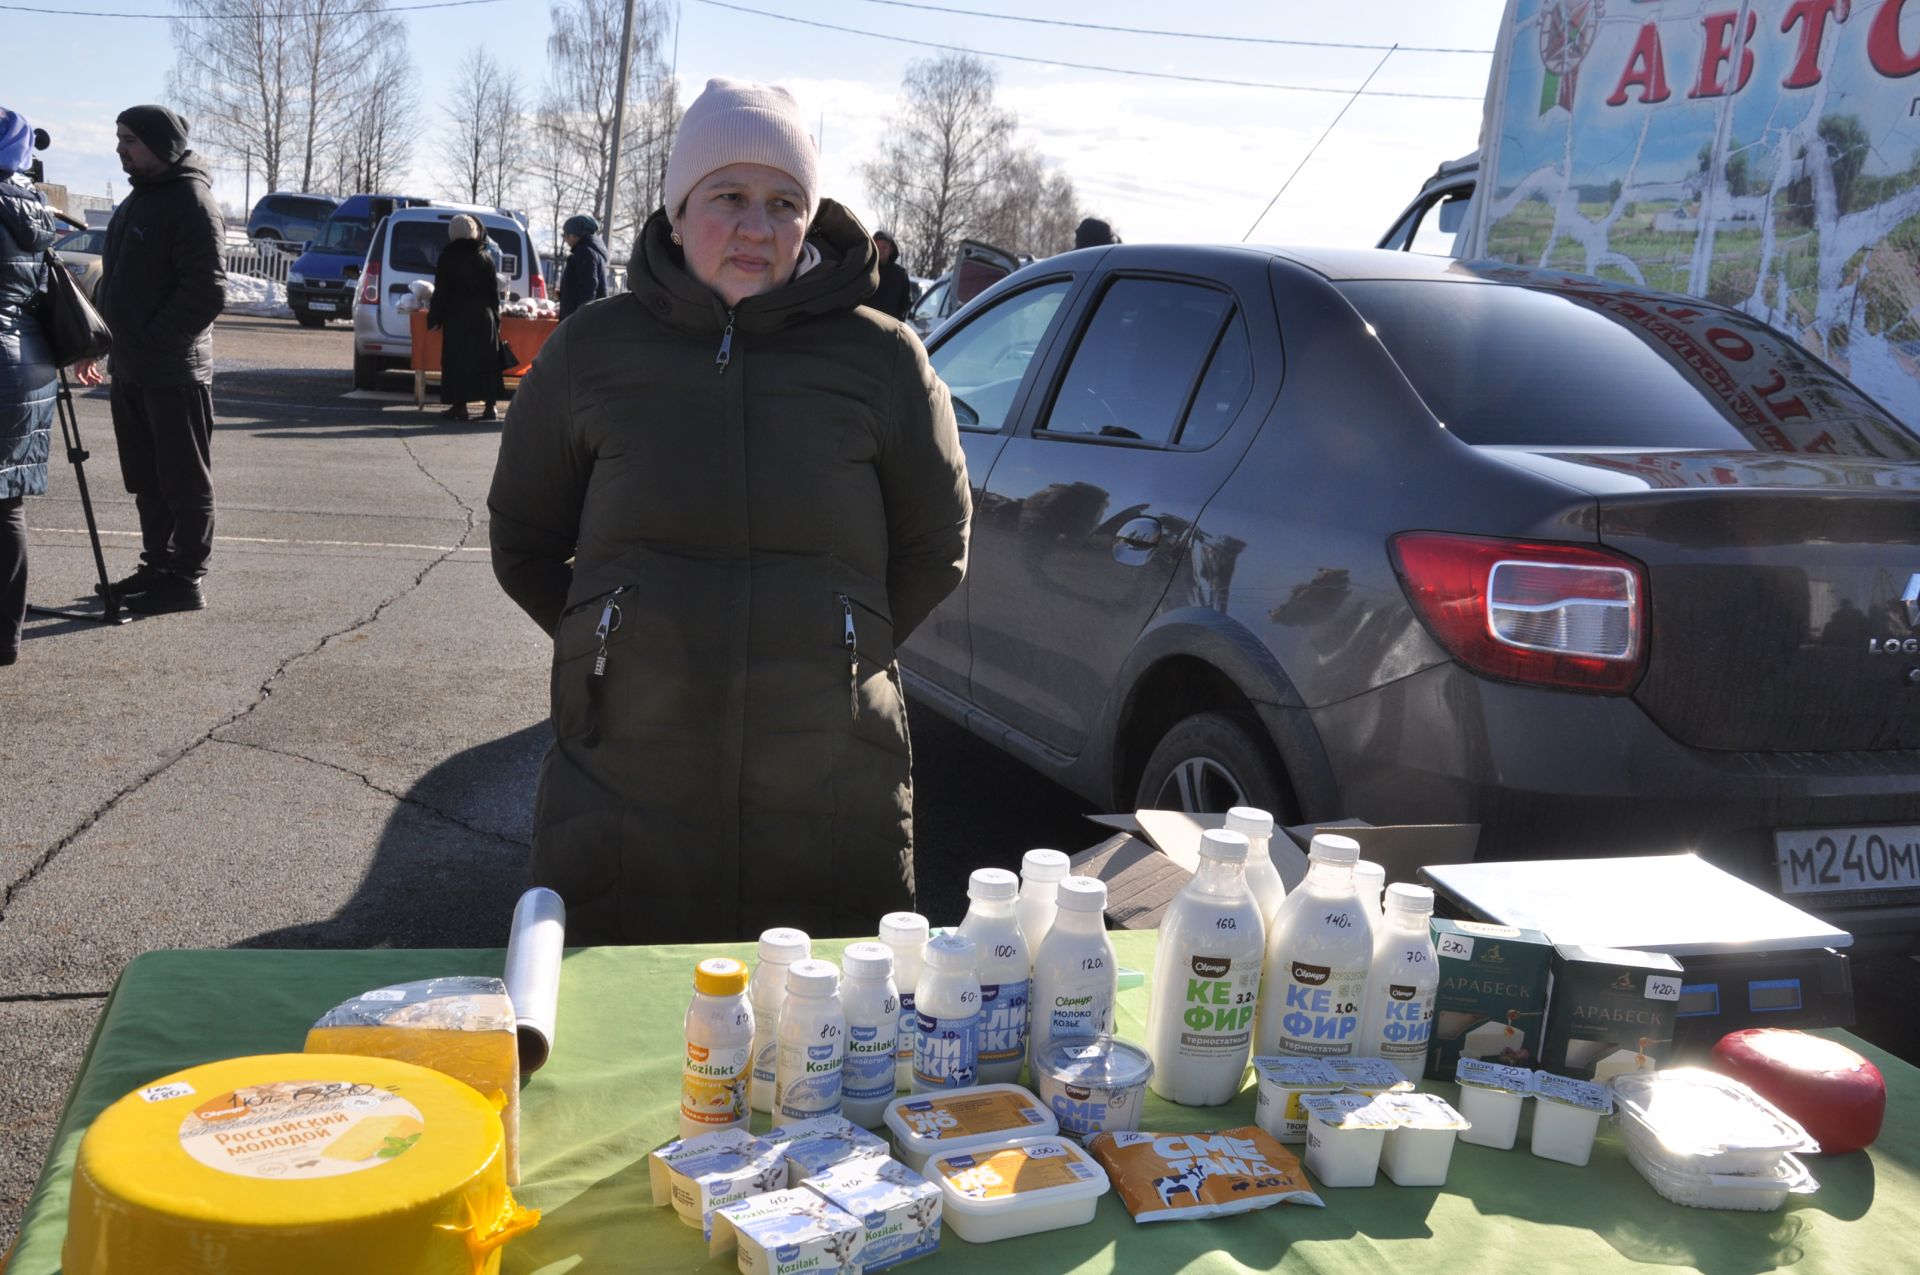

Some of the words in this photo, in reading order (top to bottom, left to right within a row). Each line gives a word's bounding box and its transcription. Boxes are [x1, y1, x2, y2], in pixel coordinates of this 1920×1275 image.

[1868, 638, 1920, 654] LOG
[1789, 834, 1920, 886] М240М
[1186, 978, 1232, 1005] КЕ
[1444, 976, 1531, 999] АРАБЕСК
[1286, 983, 1332, 1013] КЕ
[1184, 1005, 1253, 1031] ФИР
[1385, 1001, 1421, 1021] КЕ
[1572, 1005, 1663, 1025] АРАБЕСК
[1283, 1011, 1357, 1039] ФИР
[850, 1037, 897, 1053] Kozilakt
[914, 1032, 960, 1059] СЛИ
[1187, 1034, 1247, 1046] термостатный
[1284, 1040, 1350, 1053] термостатный
[686, 1057, 735, 1076] Kozilakt
[913, 1052, 960, 1078] ВКИ
[907, 1109, 950, 1121] МАС
[1053, 1094, 1107, 1121] СМЕ
[917, 1117, 958, 1132] ЛО
[1152, 1135, 1267, 1161] СМЕ
[1167, 1156, 1283, 1177] ТАНА
[709, 1190, 748, 1208] Kozilakt
[865, 1222, 903, 1242] Kozilakt
[776, 1256, 819, 1275] Kozilakt
